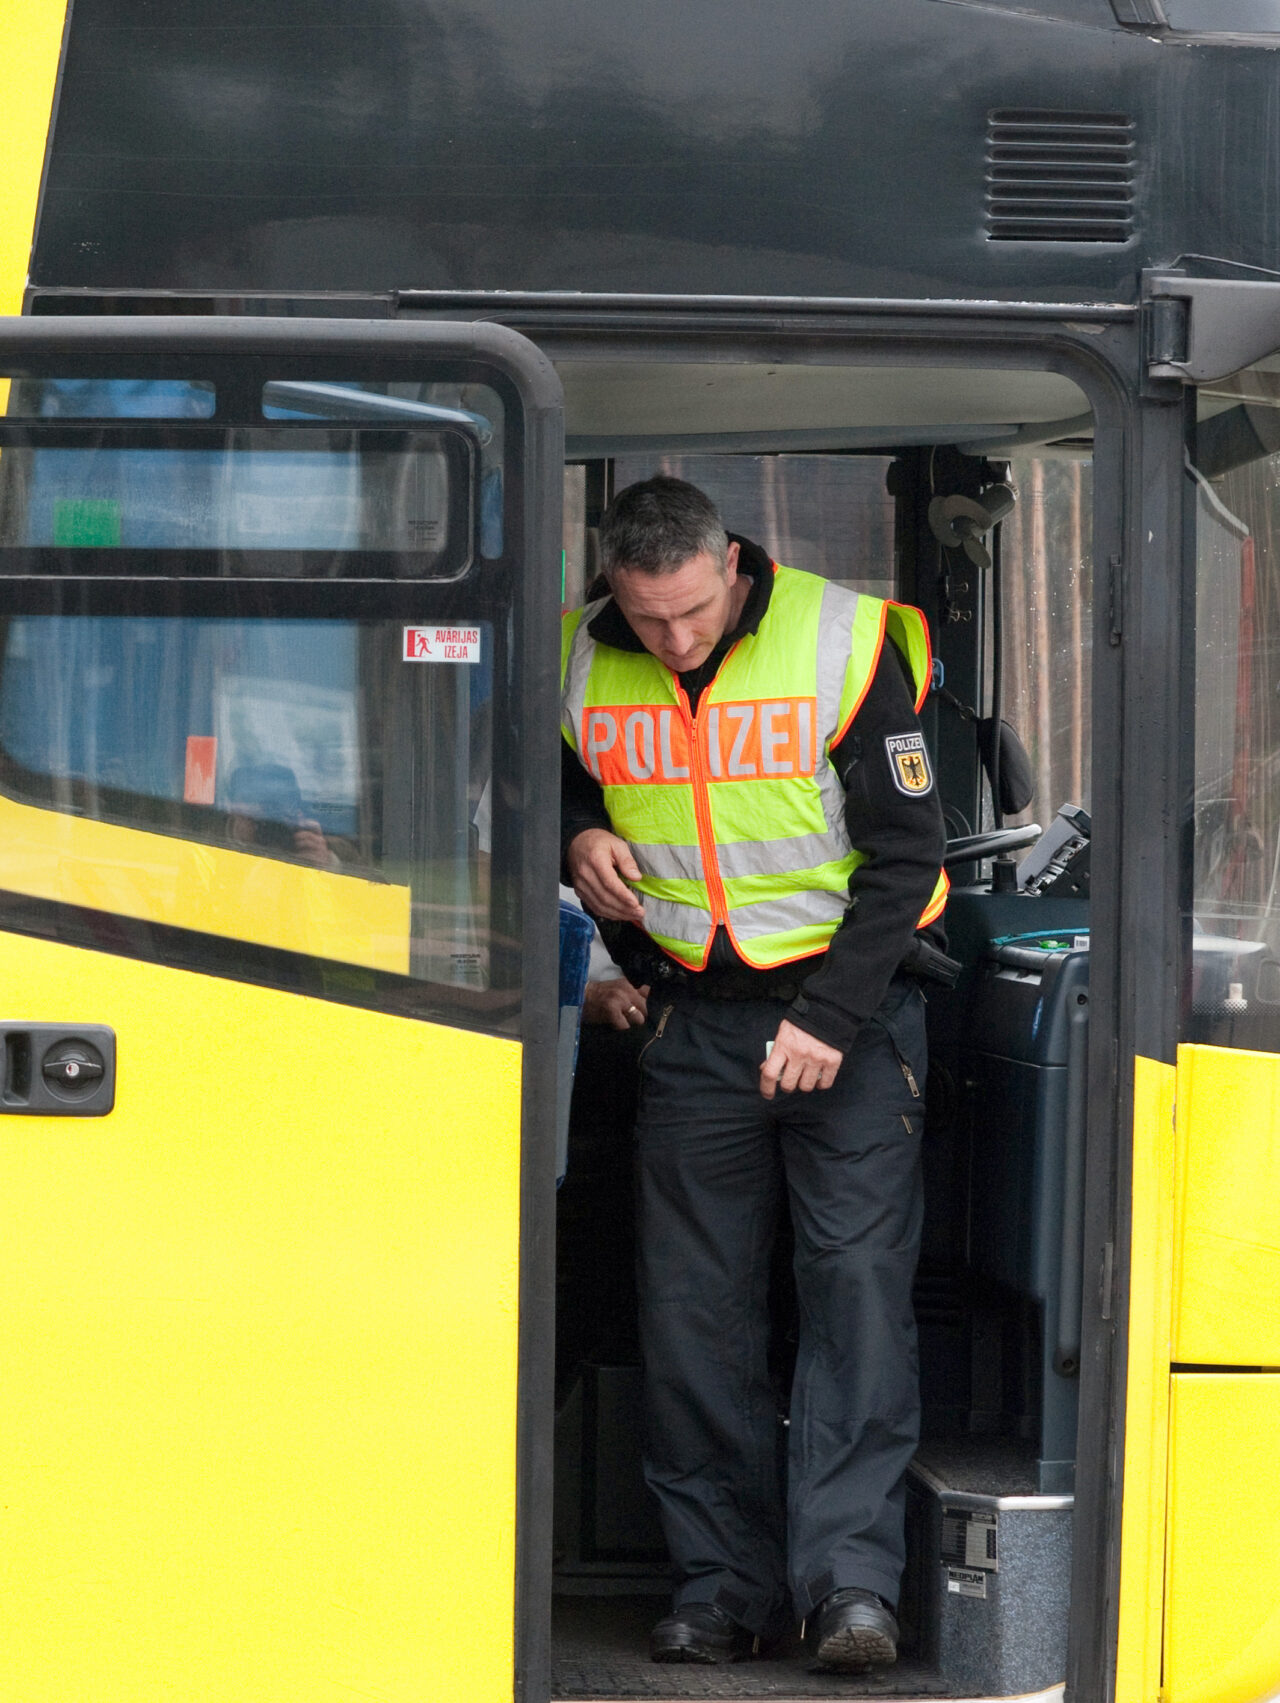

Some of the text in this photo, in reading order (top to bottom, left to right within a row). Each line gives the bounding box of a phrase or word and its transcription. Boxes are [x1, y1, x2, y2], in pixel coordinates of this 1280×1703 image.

[435, 627, 478, 644] AVĀRIJAS
[444, 645, 468, 658] IZEJA
[587, 702, 812, 780] POLIZEI
